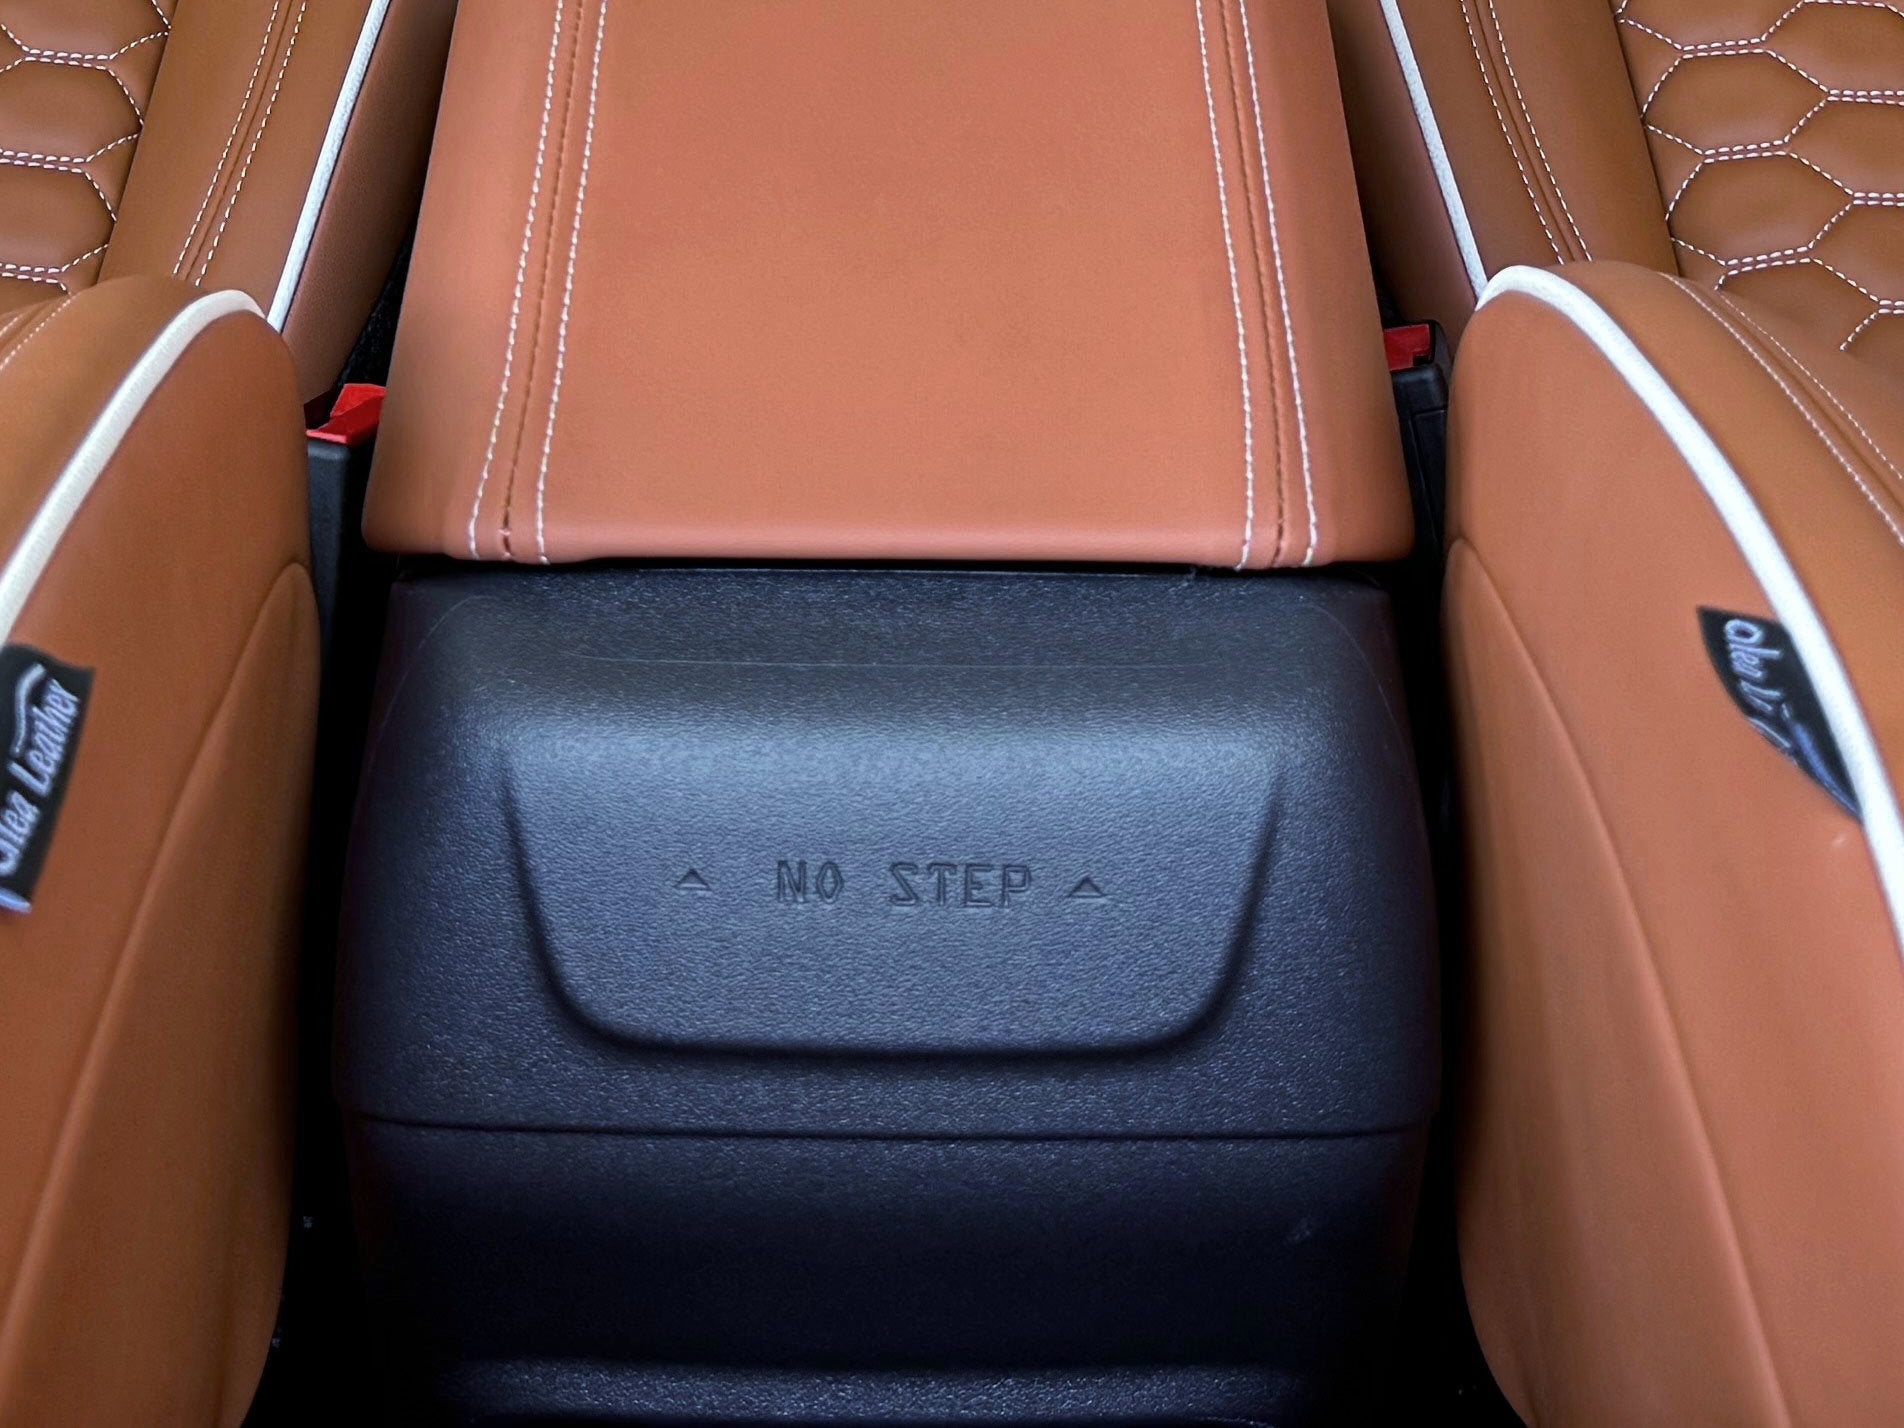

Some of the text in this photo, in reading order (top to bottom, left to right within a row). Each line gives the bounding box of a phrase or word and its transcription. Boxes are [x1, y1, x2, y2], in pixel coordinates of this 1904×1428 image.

[6, 678, 81, 797] Leather
[776, 859, 1033, 907] NO STEP
